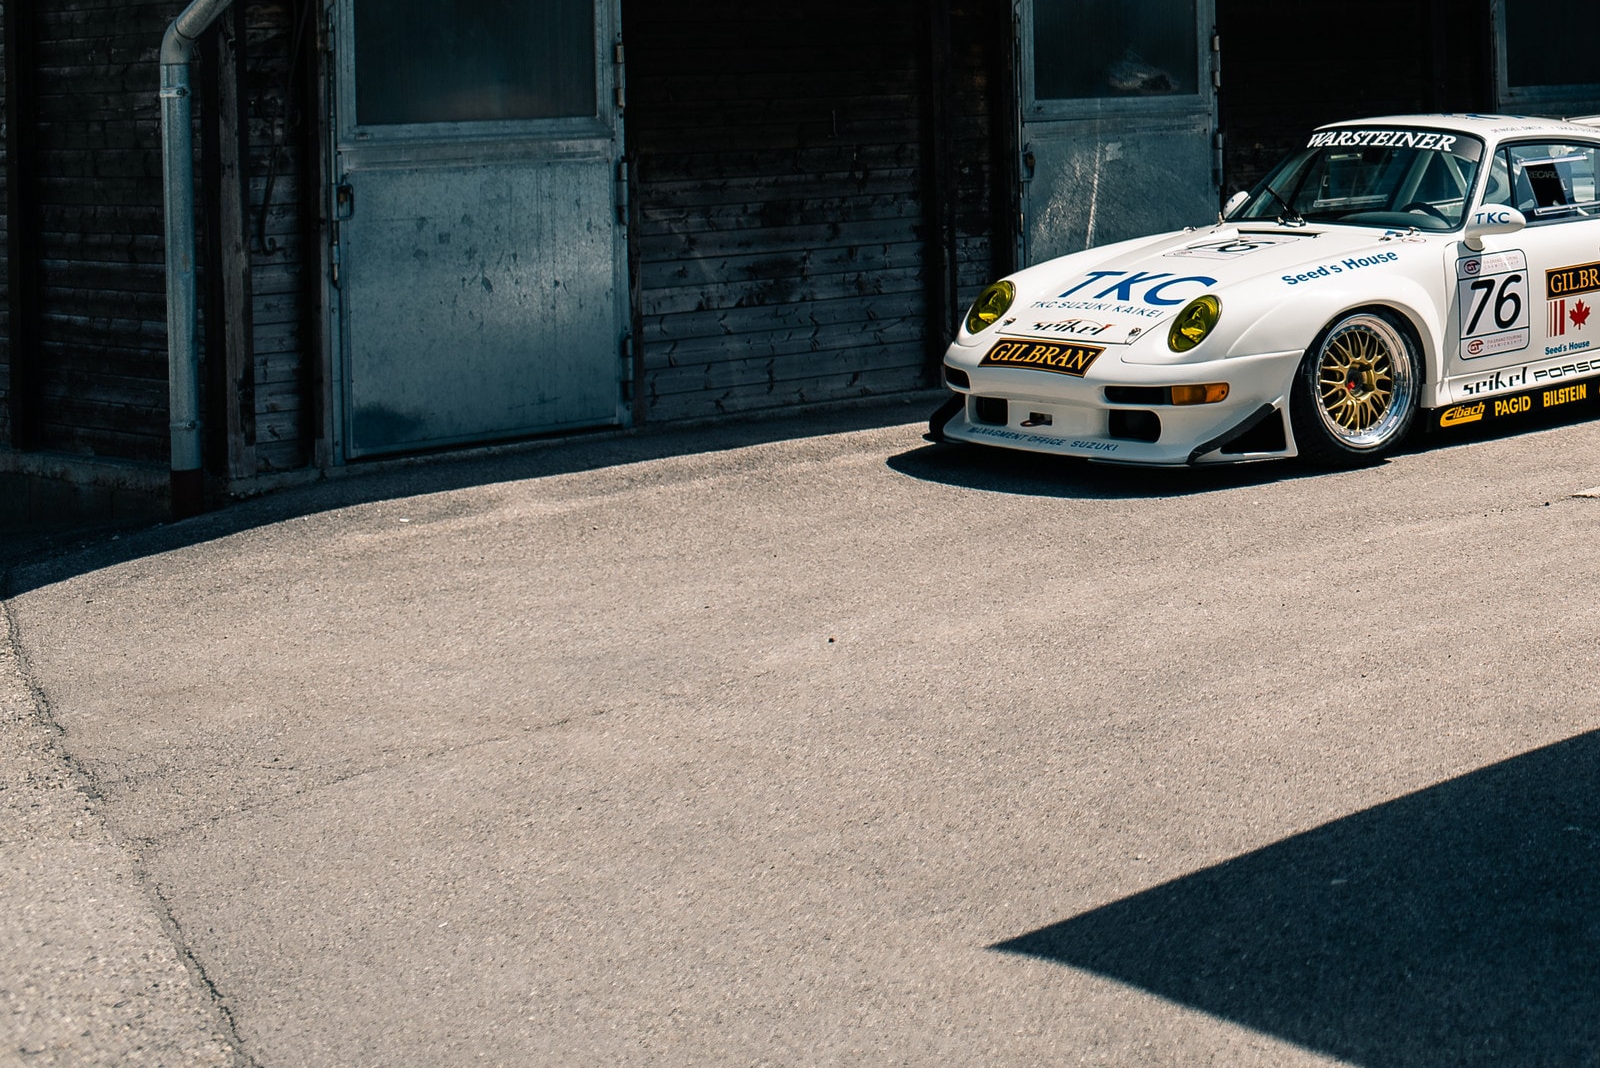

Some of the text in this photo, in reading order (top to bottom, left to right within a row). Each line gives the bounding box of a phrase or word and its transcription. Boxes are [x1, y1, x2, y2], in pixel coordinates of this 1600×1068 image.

[1306, 130, 1457, 152] WARSTEINER
[1475, 212, 1510, 224] TKC
[1282, 251, 1399, 285] Seed's House
[1058, 271, 1219, 306] TKC
[1030, 301, 1164, 318] TKC SUZUKI KAIKEI
[1465, 275, 1522, 336] 76
[990, 342, 1095, 370] GILBRAN
[1544, 340, 1590, 356] Seed's House
[1462, 367, 1528, 395] seikel
[1494, 396, 1531, 416] PAGID
[1543, 384, 1587, 407] BILSTEIN
[1440, 403, 1486, 427] Eibach
[1027, 435, 1067, 446] OFFICE
[1071, 440, 1119, 452] SUZUKI
